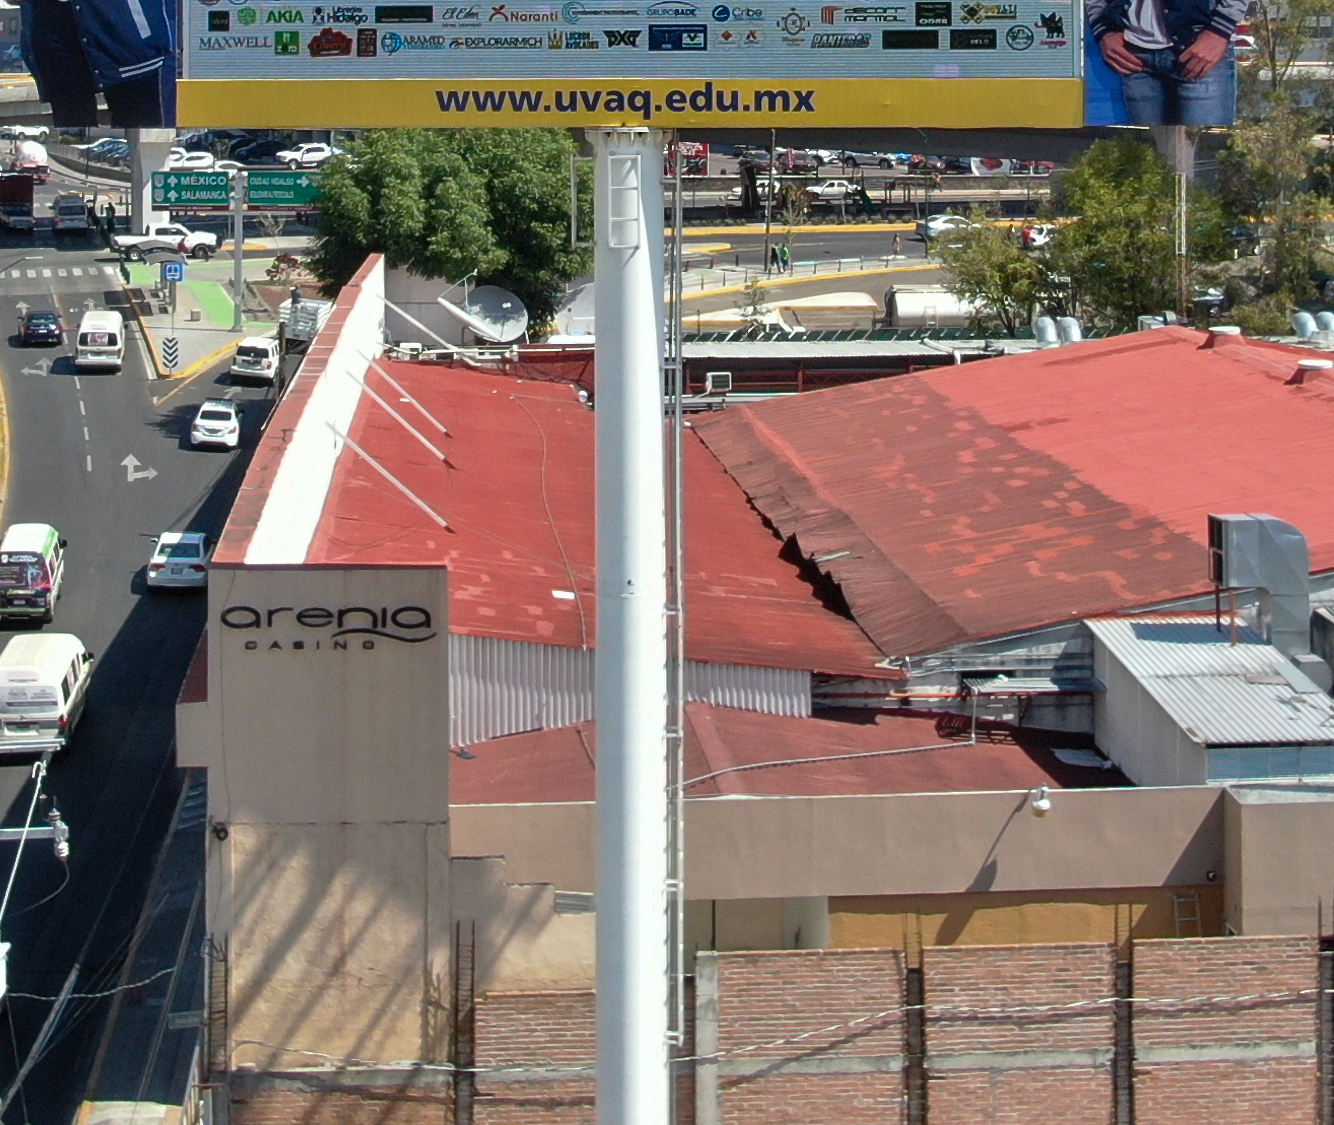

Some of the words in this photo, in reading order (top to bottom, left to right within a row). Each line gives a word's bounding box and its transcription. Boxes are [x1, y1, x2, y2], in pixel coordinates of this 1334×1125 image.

[198, 36, 273, 51] MAXWELL
[435, 81, 816, 120] www.uvaq.edu.mx
[180, 174, 227, 186] MÉXICO
[180, 190, 227, 200] SALAMANCA
[244, 640, 375, 651] CASINO
